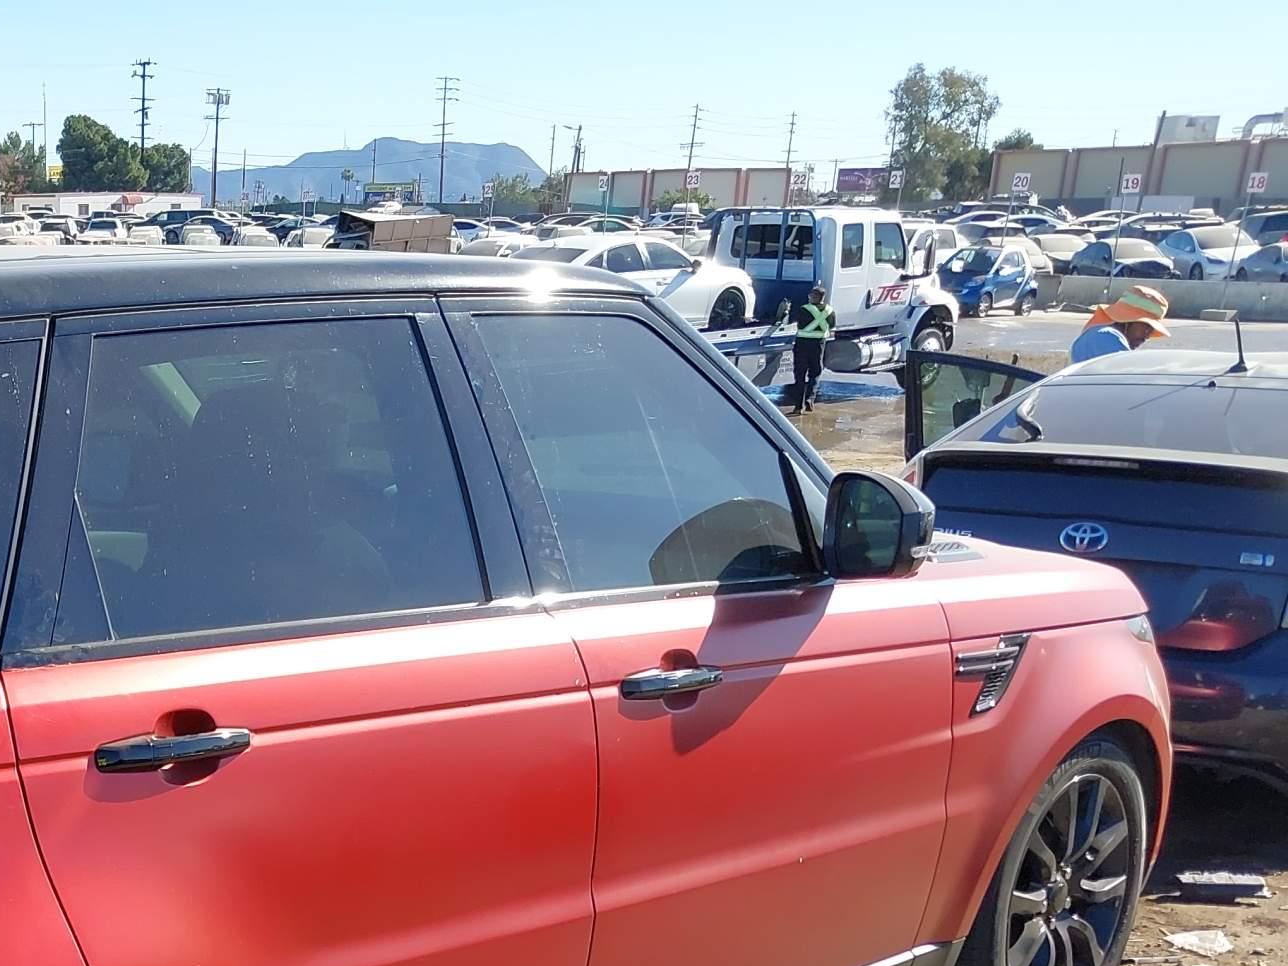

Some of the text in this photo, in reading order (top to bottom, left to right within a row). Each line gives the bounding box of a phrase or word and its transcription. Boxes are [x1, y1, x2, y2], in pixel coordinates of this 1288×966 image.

[687, 175, 699, 185] 23
[794, 174, 807, 184] 22
[1014, 175, 1029, 188] 20
[1123, 177, 1140, 189] 19
[1248, 176, 1266, 189] 18
